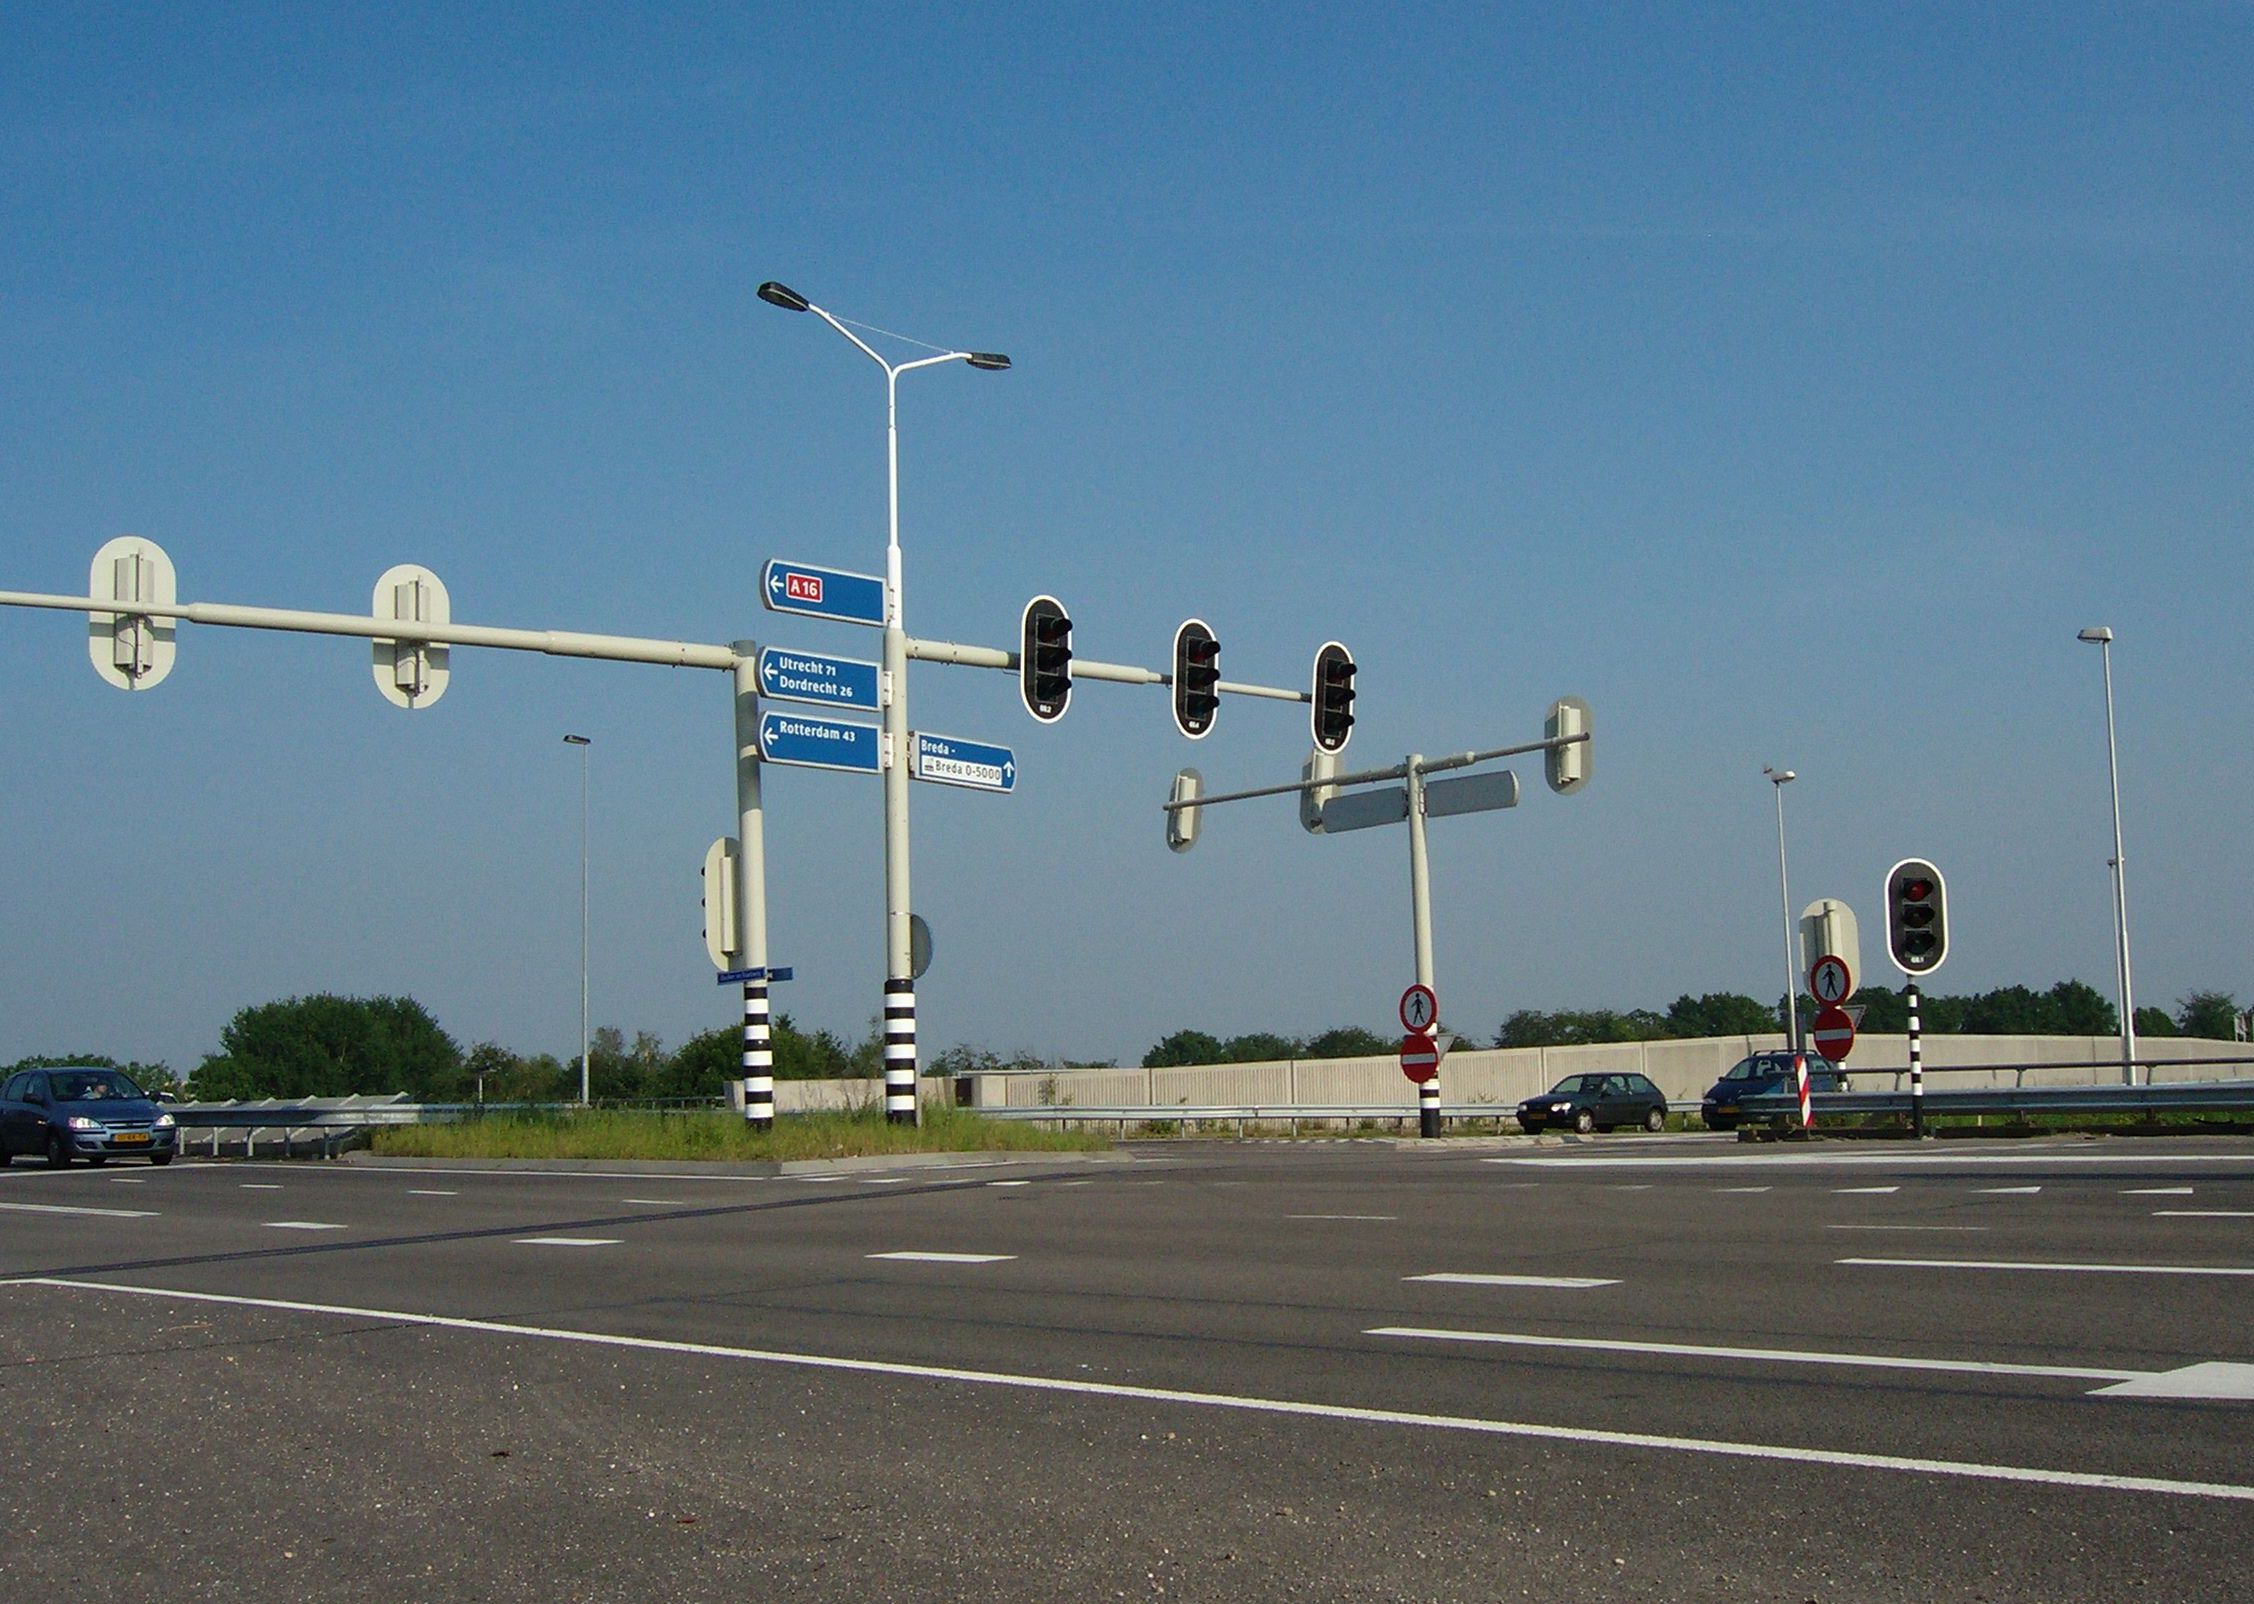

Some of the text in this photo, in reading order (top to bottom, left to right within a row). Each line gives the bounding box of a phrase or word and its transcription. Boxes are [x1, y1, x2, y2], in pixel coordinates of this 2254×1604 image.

[779, 656, 837, 676] Utrecht 71
[780, 675, 853, 697] Dordrecht 26
[780, 721, 856, 742] Rotterdam 43
[921, 739, 949, 755] Breda
[935, 760, 1001, 781] Breda 0-5000
